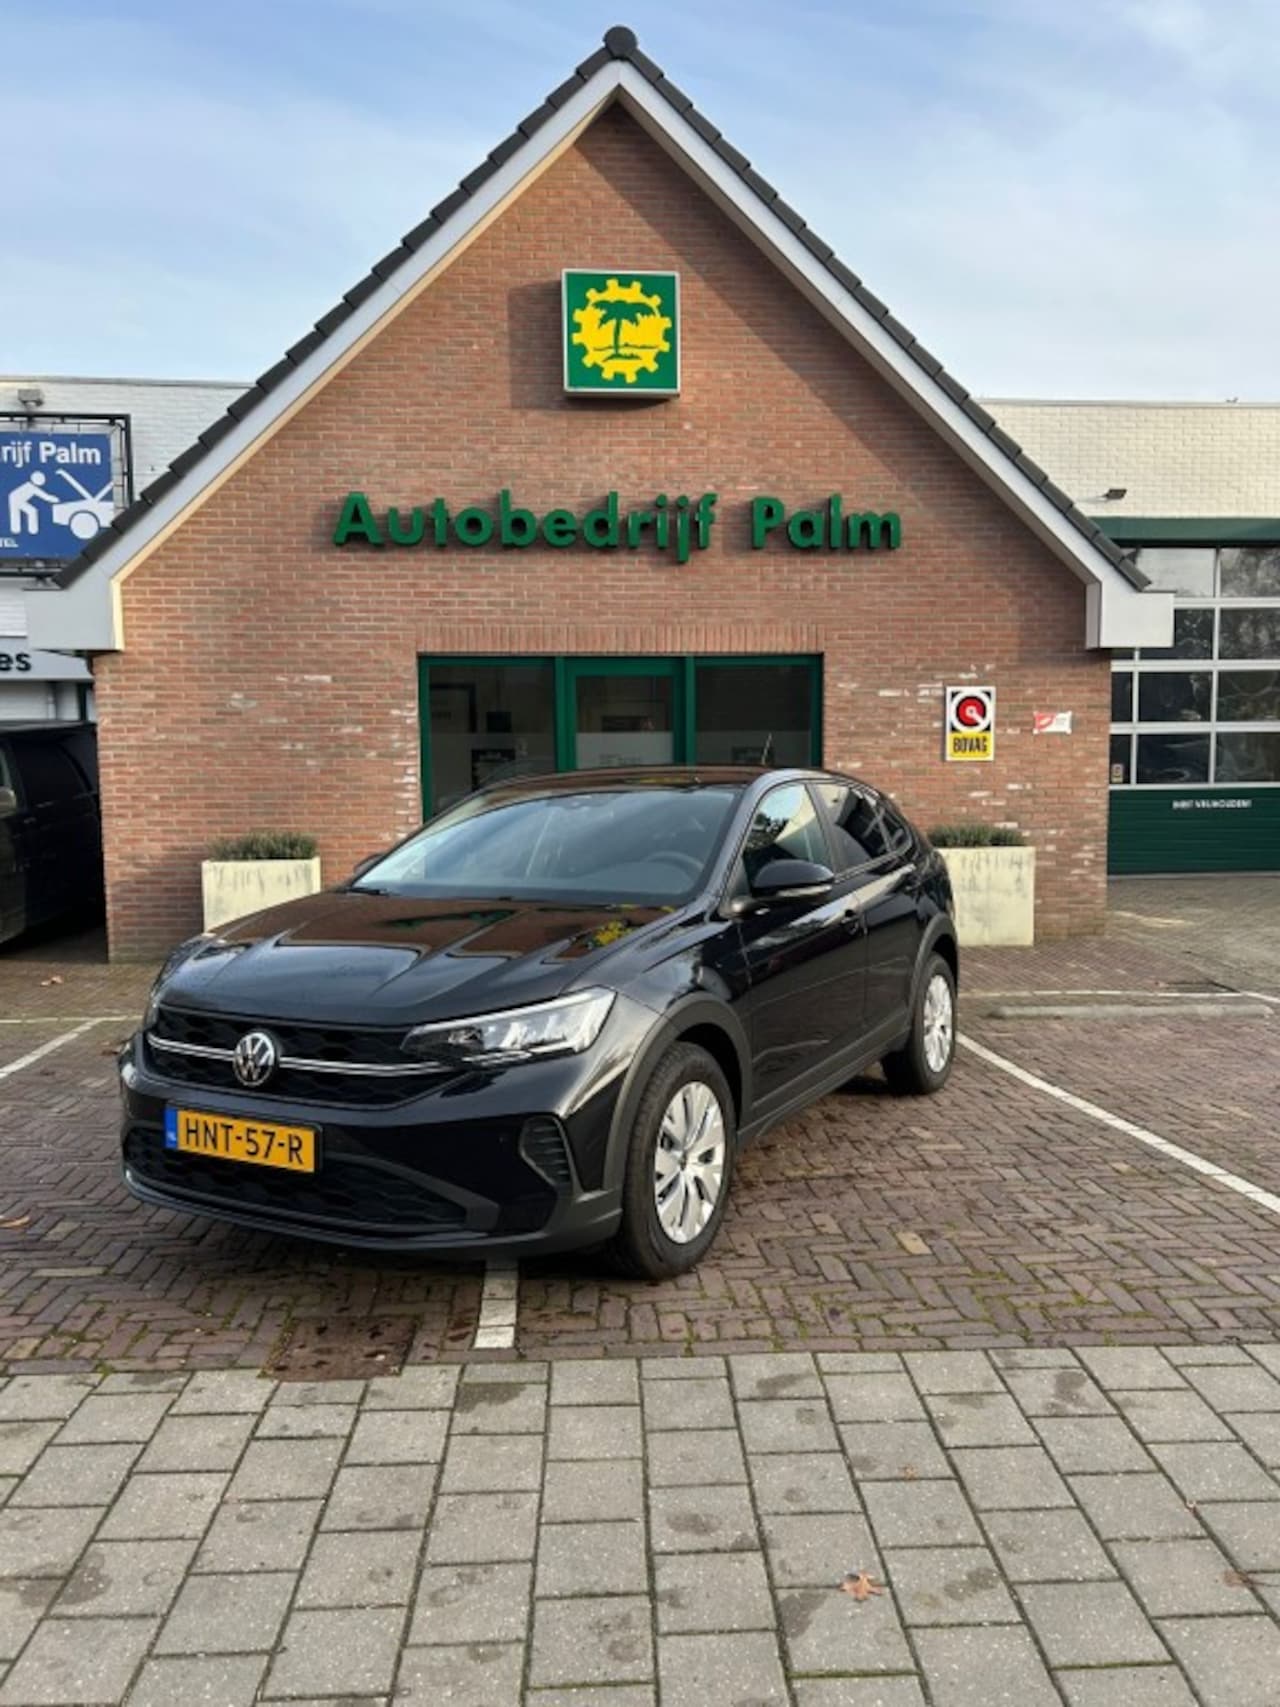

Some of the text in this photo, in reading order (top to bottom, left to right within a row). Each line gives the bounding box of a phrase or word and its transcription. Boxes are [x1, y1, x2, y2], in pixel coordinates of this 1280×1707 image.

[39, 441, 101, 465] Palm
[333, 488, 901, 563] Autobedrijf Palm
[953, 736, 988, 753] BOVAG
[185, 1117, 304, 1165] HNT-57-R
